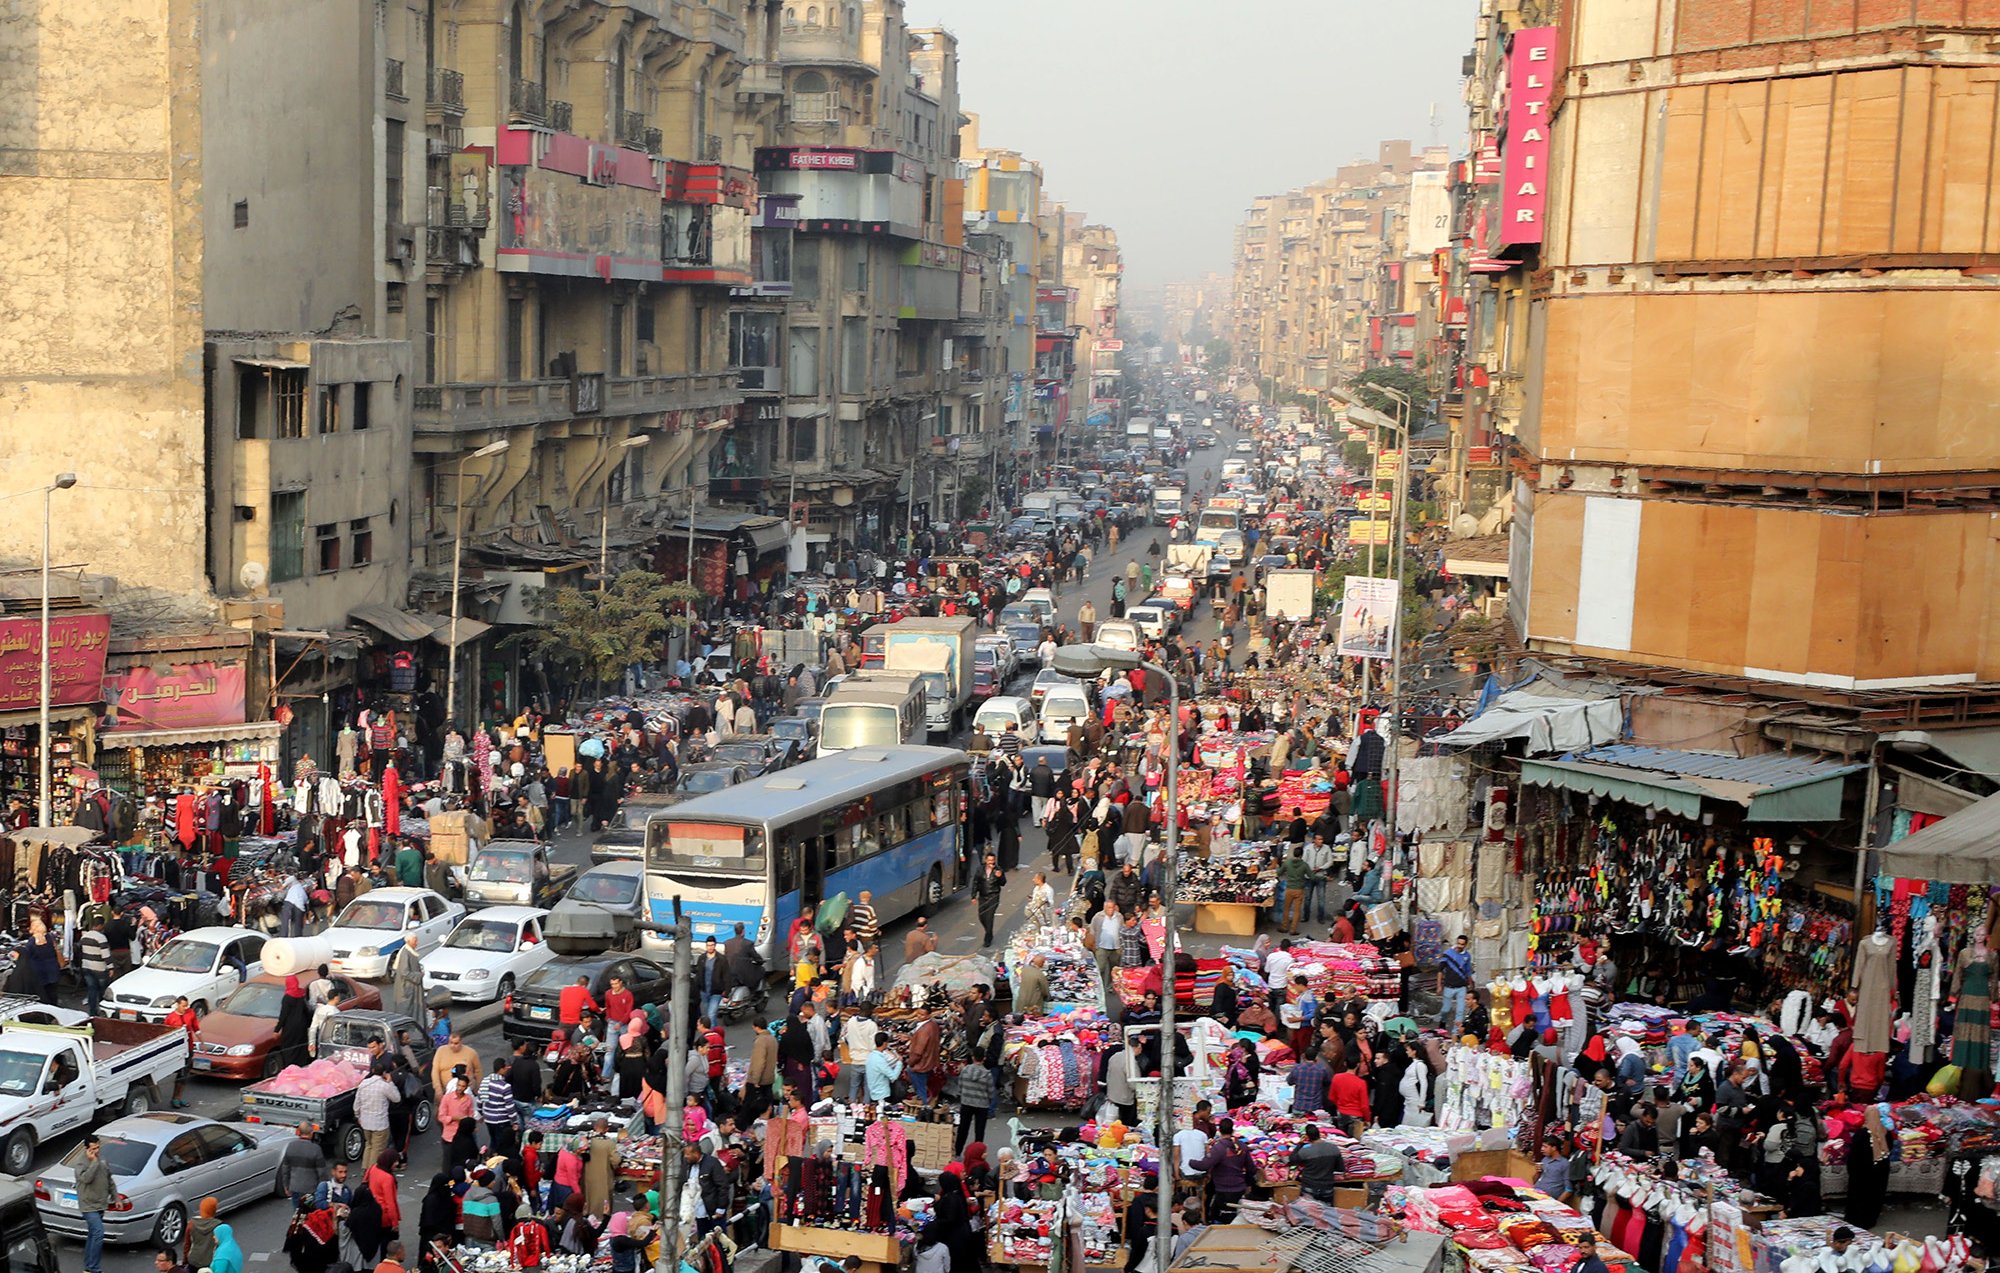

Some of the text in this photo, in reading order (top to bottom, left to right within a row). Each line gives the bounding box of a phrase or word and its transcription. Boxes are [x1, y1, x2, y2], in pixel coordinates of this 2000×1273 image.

[1515, 46, 1548, 223] ELTAIAR
[1434, 215, 1449, 229] 27
[127, 677, 216, 704] الحرمين
[255, 1097, 309, 1110] SUZUKI
